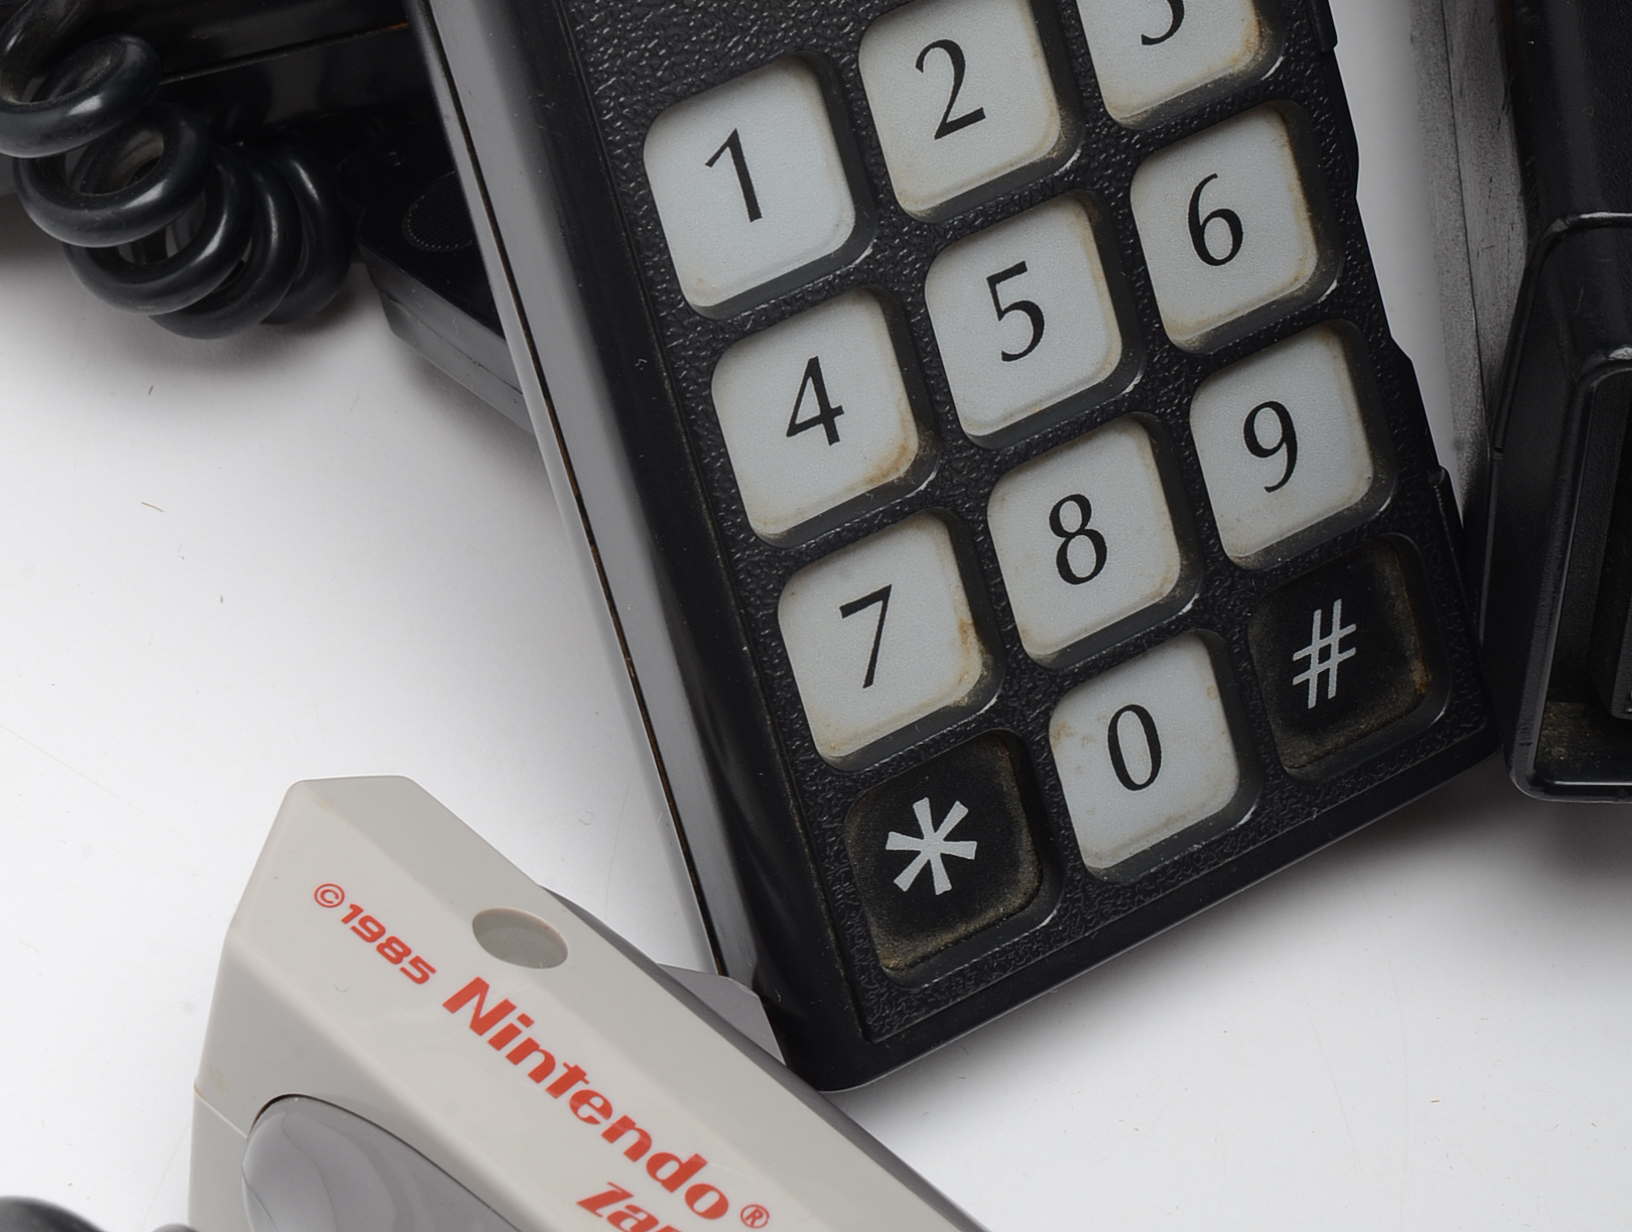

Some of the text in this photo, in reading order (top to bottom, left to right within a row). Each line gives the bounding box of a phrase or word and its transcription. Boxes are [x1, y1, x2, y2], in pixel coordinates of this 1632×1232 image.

[915, 38, 987, 141] 2
[704, 127, 763, 223] 1
[1187, 172, 1245, 267] 6
[985, 260, 1046, 363] 5
[785, 355, 845, 447] 4
[1242, 400, 1299, 494] 9
[1048, 493, 1108, 586] 8
[838, 583, 893, 689] 7
[1292, 599, 1356, 709] #
[1107, 703, 1163, 792] 0
[576, 1181, 682, 1232] Za
